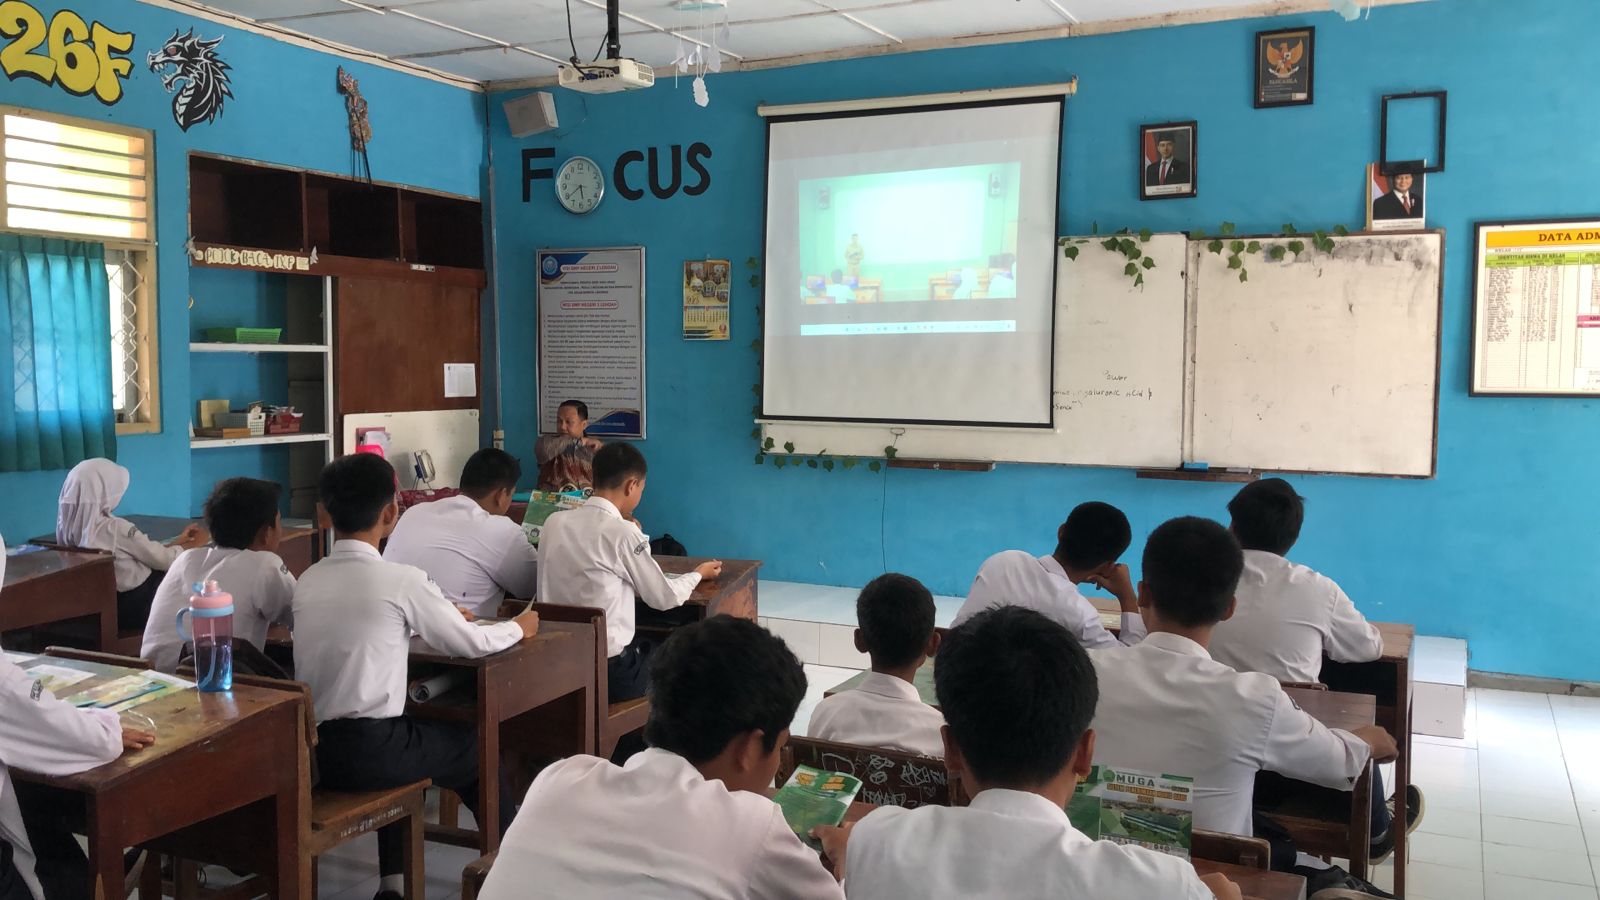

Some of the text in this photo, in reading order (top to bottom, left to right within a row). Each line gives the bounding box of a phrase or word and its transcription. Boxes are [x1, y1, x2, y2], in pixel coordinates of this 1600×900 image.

[0, 0, 135, 106] 26F
[1538, 233, 1572, 242] DATA
[1116, 774, 1155, 787] MUGA
